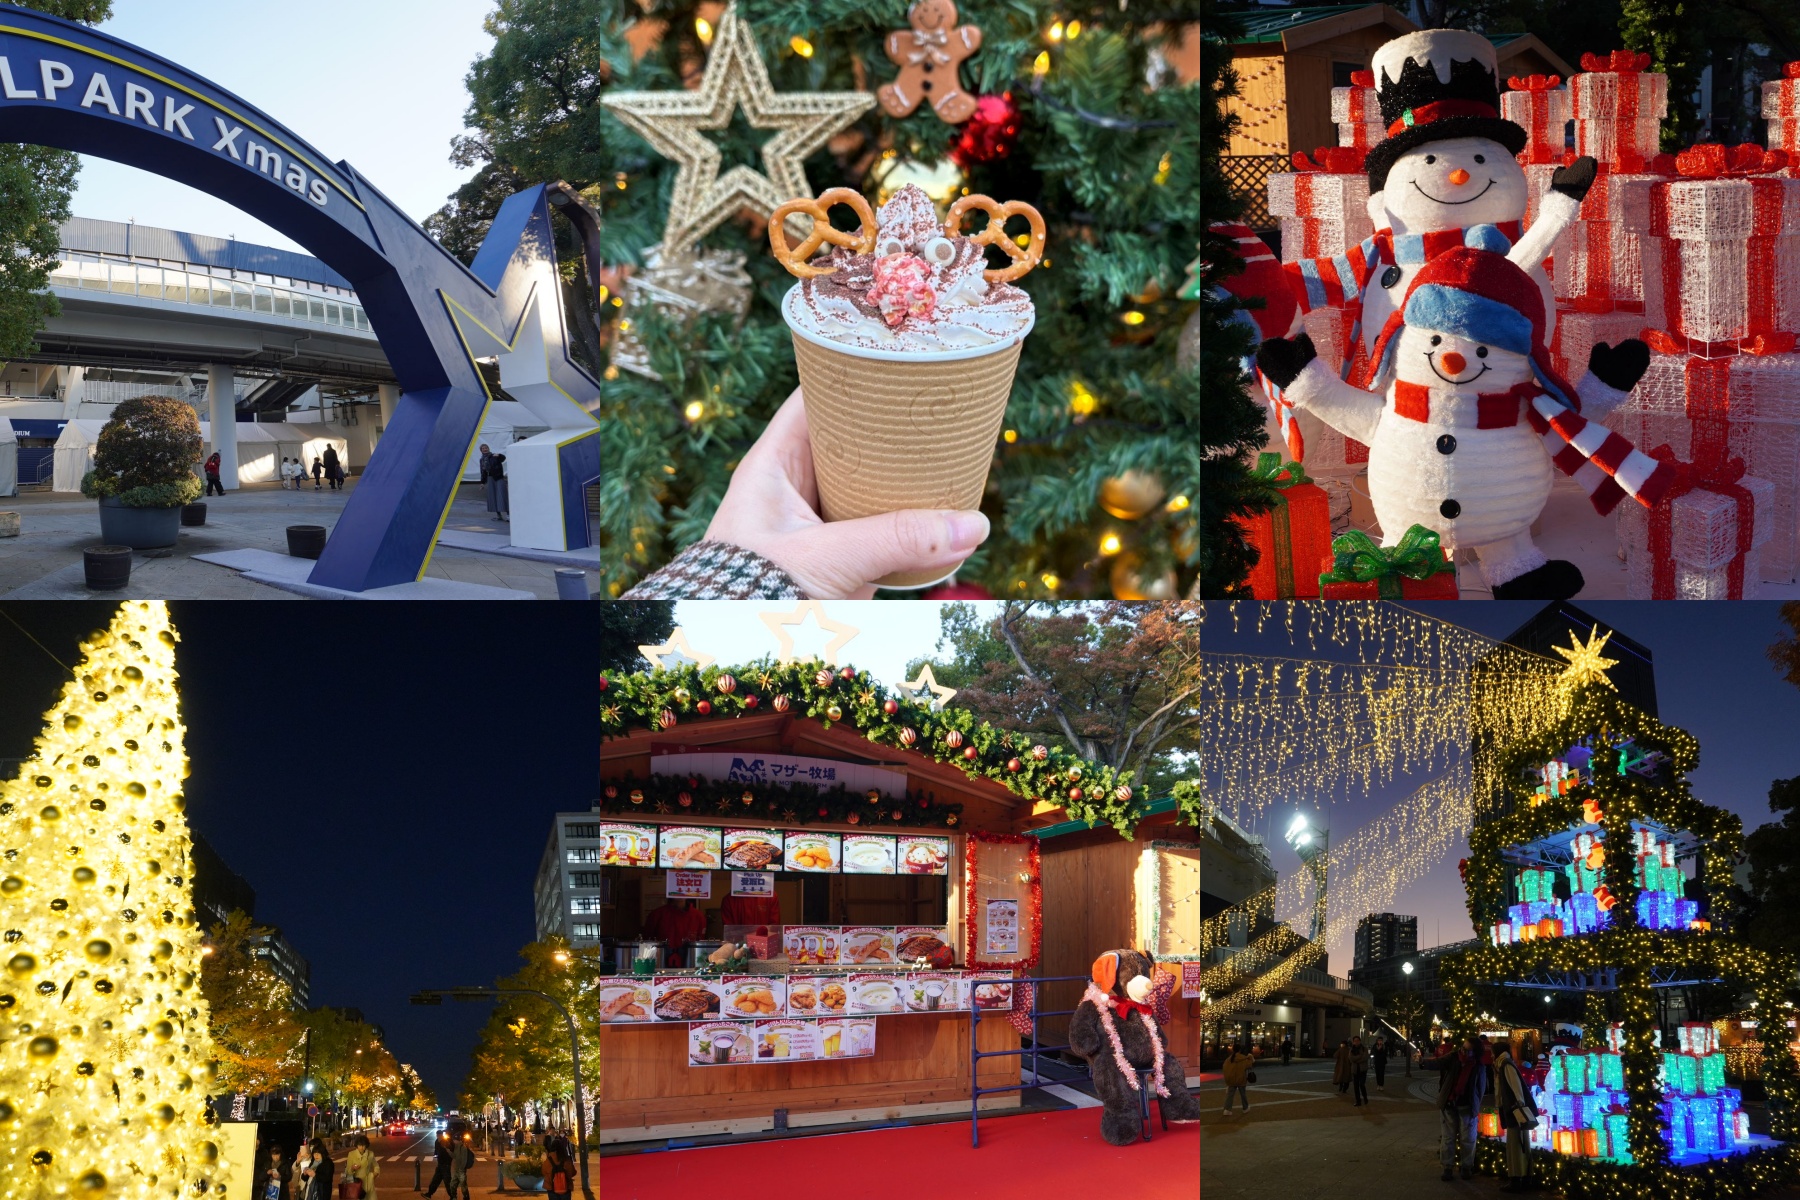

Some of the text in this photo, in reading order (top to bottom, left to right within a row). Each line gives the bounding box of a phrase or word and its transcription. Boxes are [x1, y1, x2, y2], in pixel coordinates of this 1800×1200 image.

[0, 56, 330, 207] LPARK Xmas
[770, 763, 836, 781] マザー牧場
[676, 878, 702, 887] 注文口
[741, 877, 765, 886] 受取口
